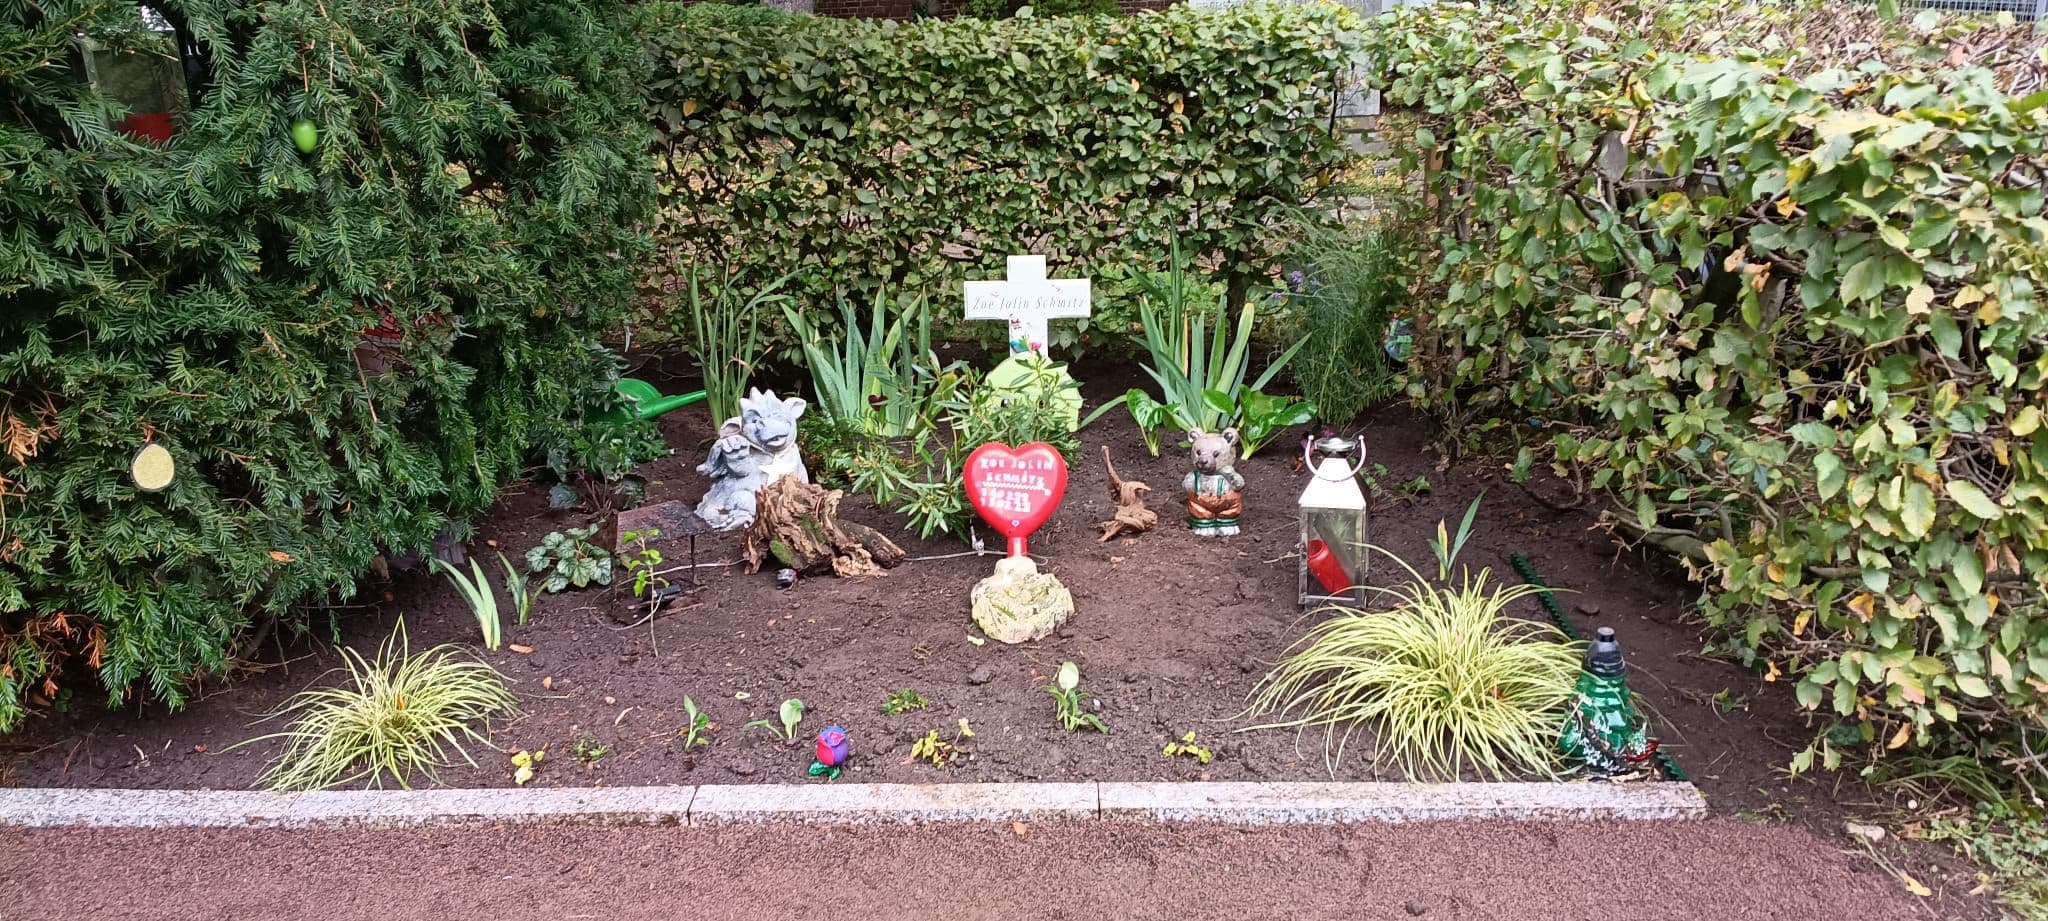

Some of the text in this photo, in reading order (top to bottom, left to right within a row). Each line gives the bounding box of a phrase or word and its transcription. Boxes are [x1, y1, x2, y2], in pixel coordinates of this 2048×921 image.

[999, 296, 1030, 312] Jolin
[1035, 296, 1085, 310] Schmitz
[1010, 459, 1053, 470] JOLIN
